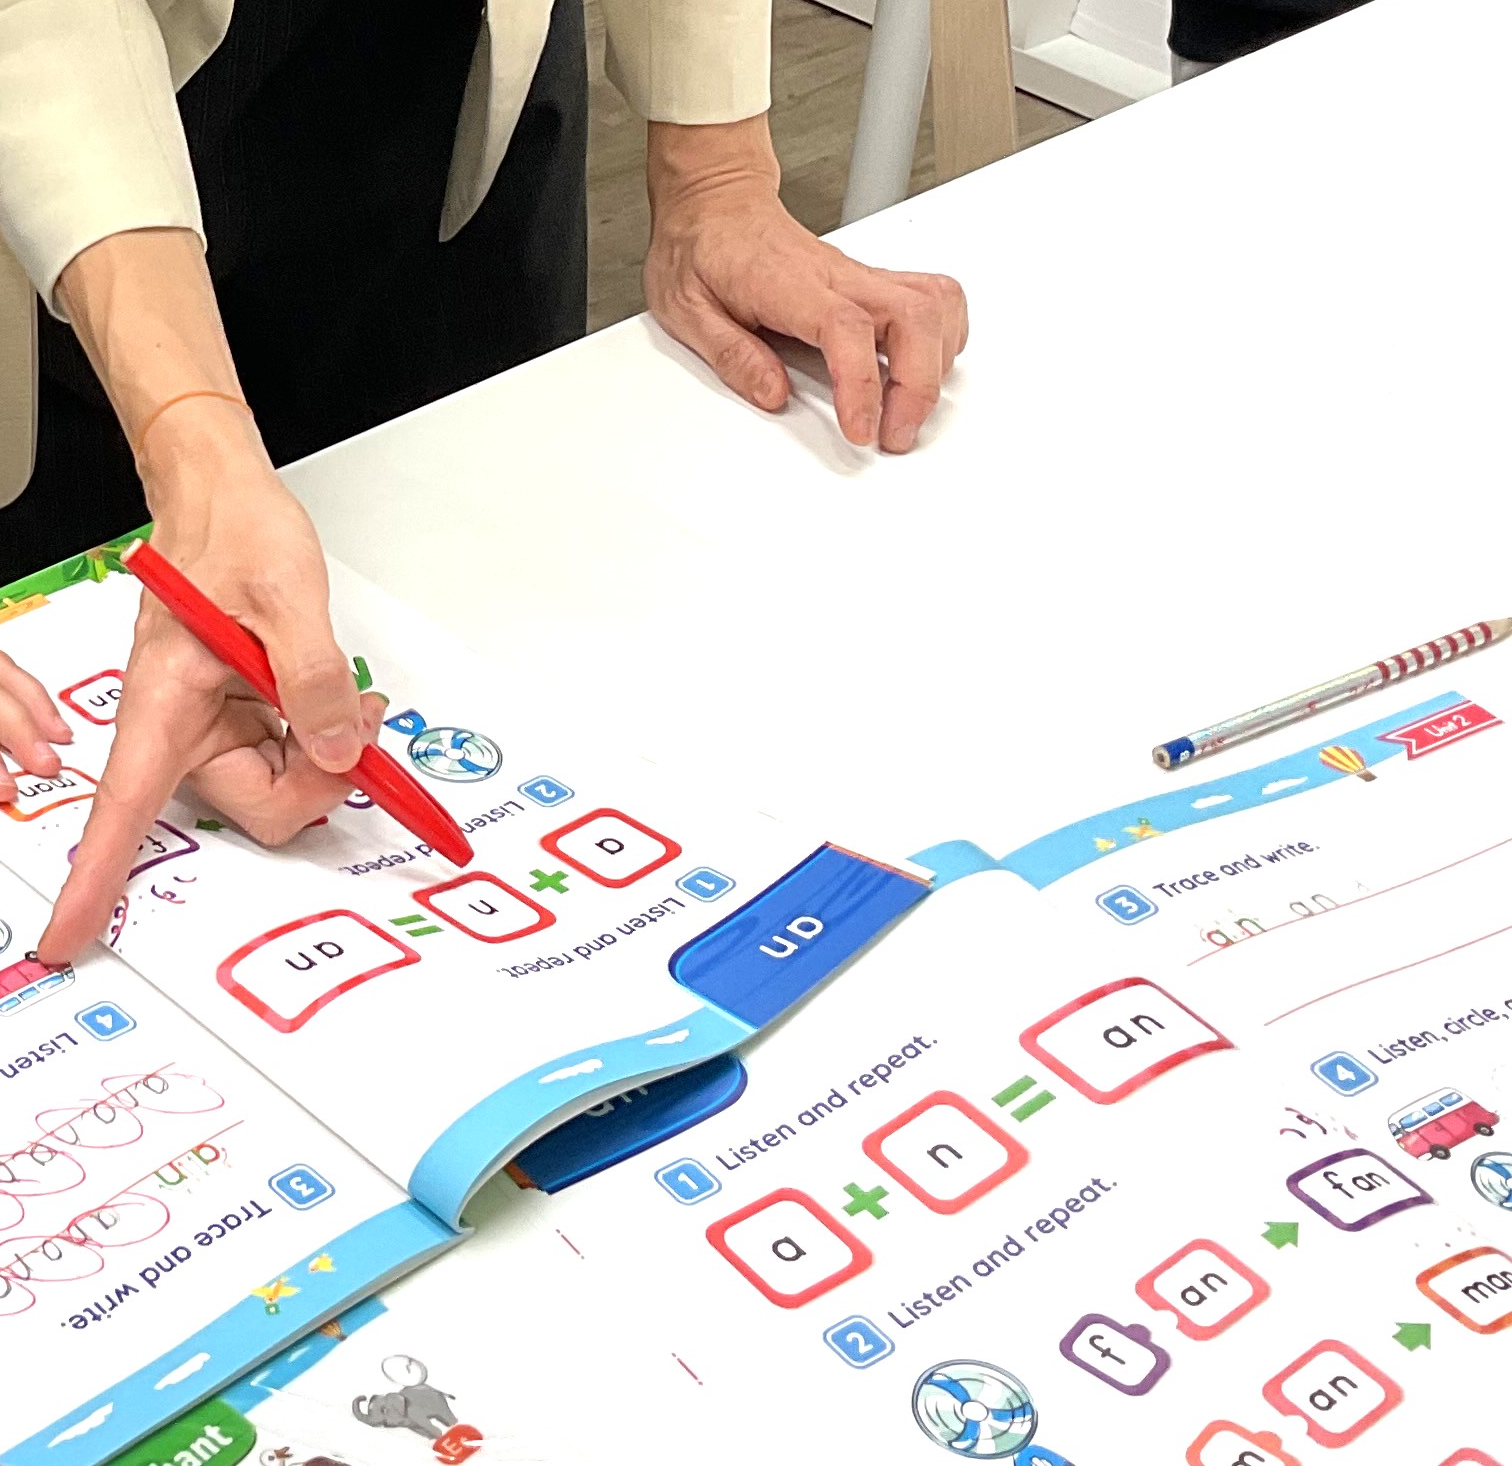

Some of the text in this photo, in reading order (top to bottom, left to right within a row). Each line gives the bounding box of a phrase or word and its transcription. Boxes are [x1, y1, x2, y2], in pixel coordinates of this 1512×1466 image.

[1452, 714, 1472, 727] 2
[19, 778, 77, 797] man
[462, 801, 525, 833] Listen
[338, 850, 416, 876] repeat.
[595, 838, 625, 855] a
[1152, 870, 1220, 898] Trace
[1219, 854, 1262, 876] and
[1259, 841, 1320, 864] write.
[468, 900, 499, 915] n
[617, 898, 686, 937] Listen
[574, 933, 617, 961] and
[759, 916, 824, 958] an
[285, 941, 345, 971] an
[496, 953, 575, 979] repeat.
[1103, 1014, 1166, 1048] an
[1367, 1030, 1449, 1065] Listen,
[1443, 1008, 1510, 1035] circle,
[716, 1124, 796, 1170] Listen
[797, 1088, 849, 1127] and
[848, 1036, 938, 1096] repeat.
[926, 1143, 963, 1168] n
[194, 1200, 272, 1246] Trace
[772, 1236, 807, 1262] a
[887, 1274, 973, 1329] Listen
[972, 1235, 1026, 1277] and
[1024, 1178, 1118, 1243] repeat.
[139, 1246, 191, 1288] and
[1180, 1272, 1228, 1307] an
[61, 1284, 139, 1329] write.
[1088, 1334, 1127, 1365] f
[1309, 1375, 1358, 1411] an
